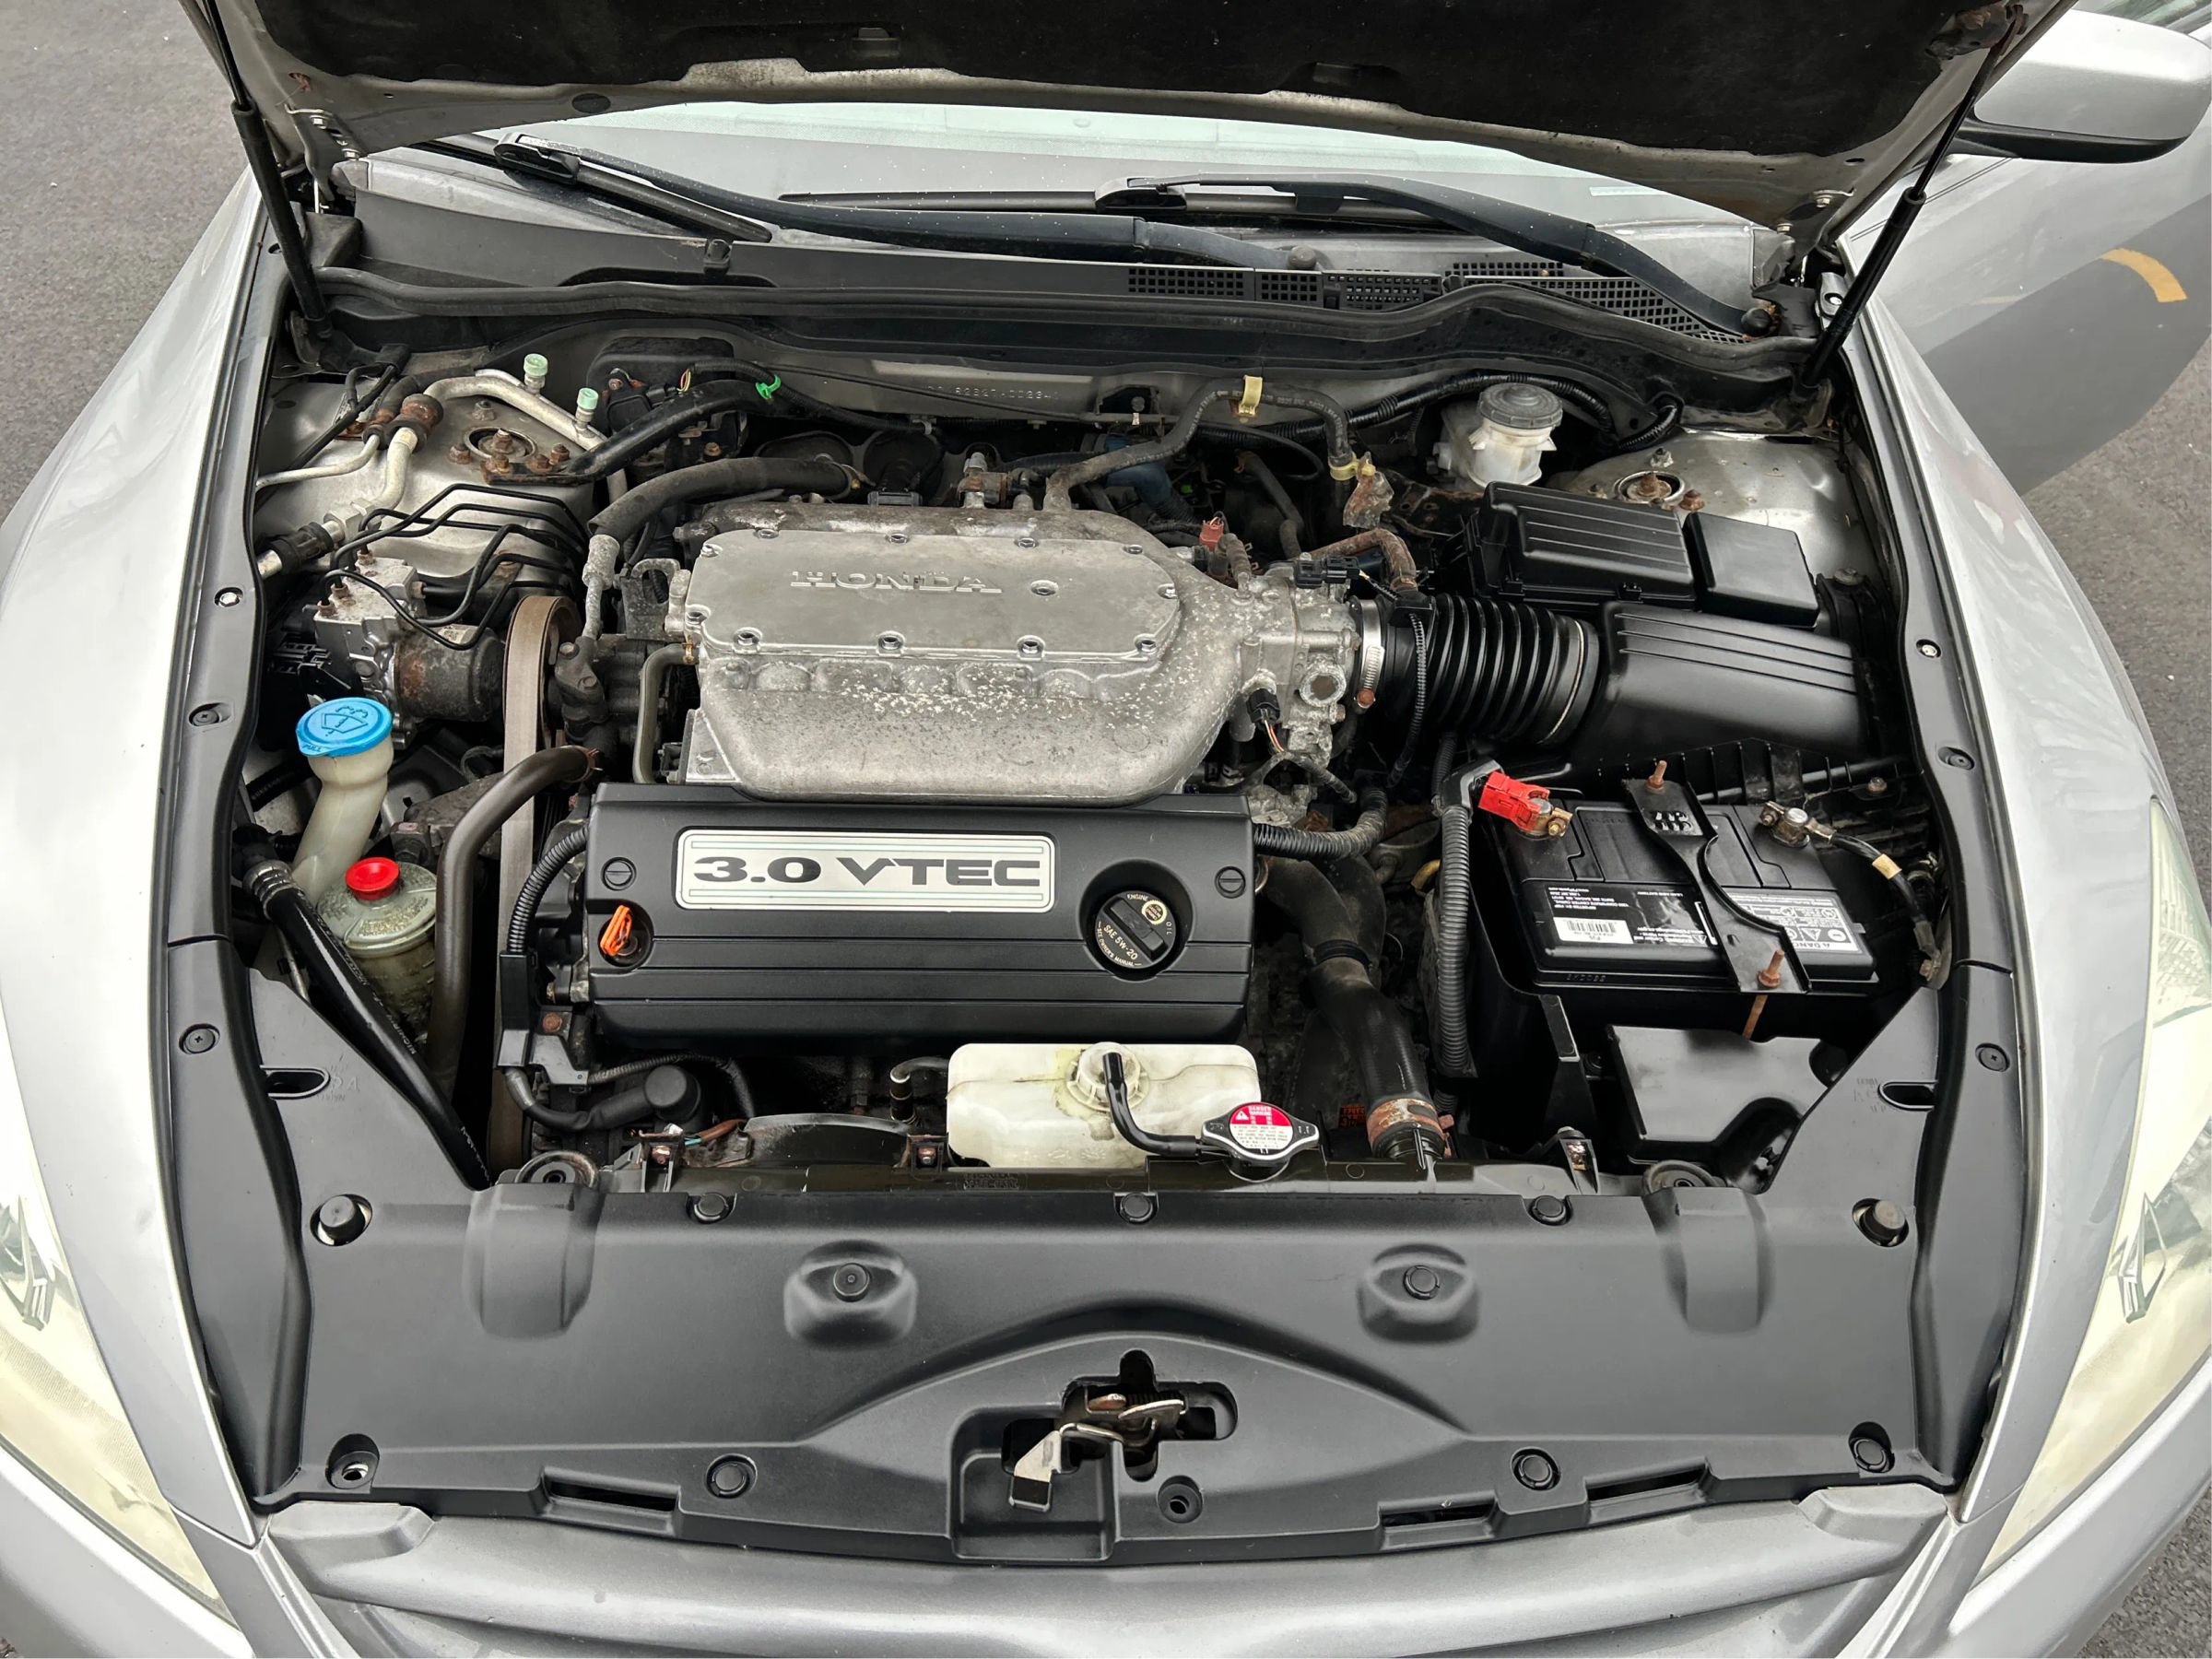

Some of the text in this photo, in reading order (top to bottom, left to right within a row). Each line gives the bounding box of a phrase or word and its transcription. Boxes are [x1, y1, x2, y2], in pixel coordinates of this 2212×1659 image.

[790, 570, 1003, 594] HONDA
[693, 855, 1041, 887] 3.0 VTEC
[1126, 893, 1149, 901] ENGINE
[1103, 924, 1138, 960] SAE 5W-20
[1113, 956, 1135, 967] MANUAL
